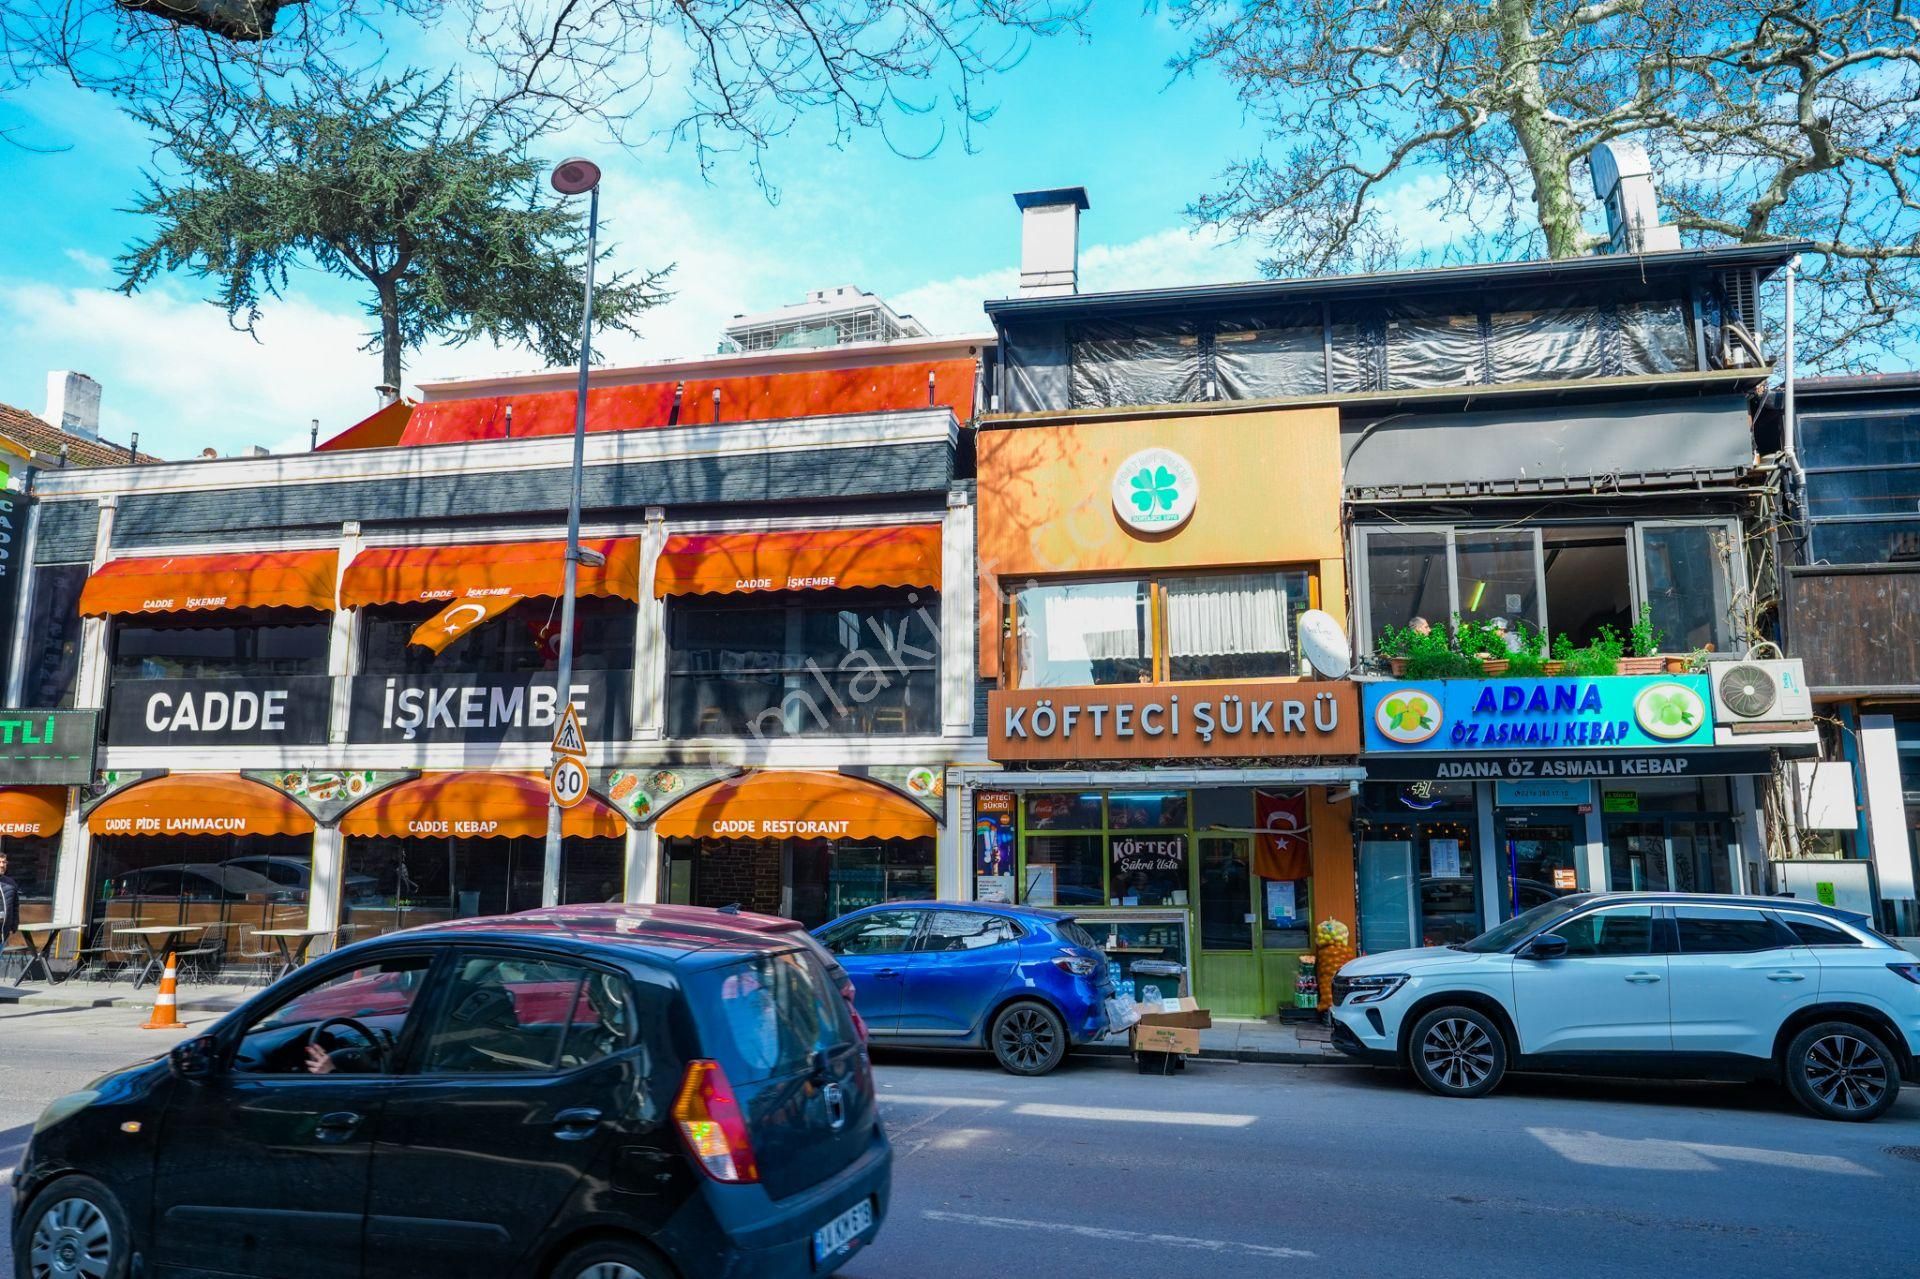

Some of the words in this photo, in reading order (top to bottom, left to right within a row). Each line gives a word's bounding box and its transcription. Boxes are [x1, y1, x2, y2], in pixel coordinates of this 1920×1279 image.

[735, 579, 772, 588] CADDE
[787, 576, 835, 588] İŞKEMBE
[467, 587, 512, 597] İŞKEMBE
[143, 600, 174, 608] CADDE
[186, 597, 227, 608] İŞKEMBE
[1472, 684, 1603, 714] ADANA
[145, 691, 288, 732] CADDE
[383, 678, 590, 739] İŞKEMBE
[1005, 694, 1180, 738] KÖFTECİ
[1193, 692, 1339, 742] ŞÜKRÜ
[1451, 720, 1479, 744] ÖZ
[1483, 722, 1559, 744] ASMALI
[1563, 720, 1629, 744] KEBAP
[1437, 762, 1502, 778] ADANA
[1508, 759, 1536, 777] ÖZ
[1540, 761, 1615, 776] ASMALI
[1621, 758, 1688, 775] KEBAP
[556, 772, 581, 794] 30
[980, 793, 1011, 801] KÖFTECİ
[983, 801, 1008, 810] ŞÜKRÜ
[105, 819, 132, 830] CADDE
[136, 816, 160, 831] PİDE
[166, 817, 246, 830] LAHMACUN
[408, 821, 449, 833] CADDE
[454, 820, 498, 833] KEBAP
[712, 820, 755, 833] CADDE
[762, 820, 849, 833] RESTORANT
[1112, 838, 1183, 864] KÖFTECİ
[1120, 858, 1154, 873] Şükrü
[1156, 859, 1179, 870] Usta
